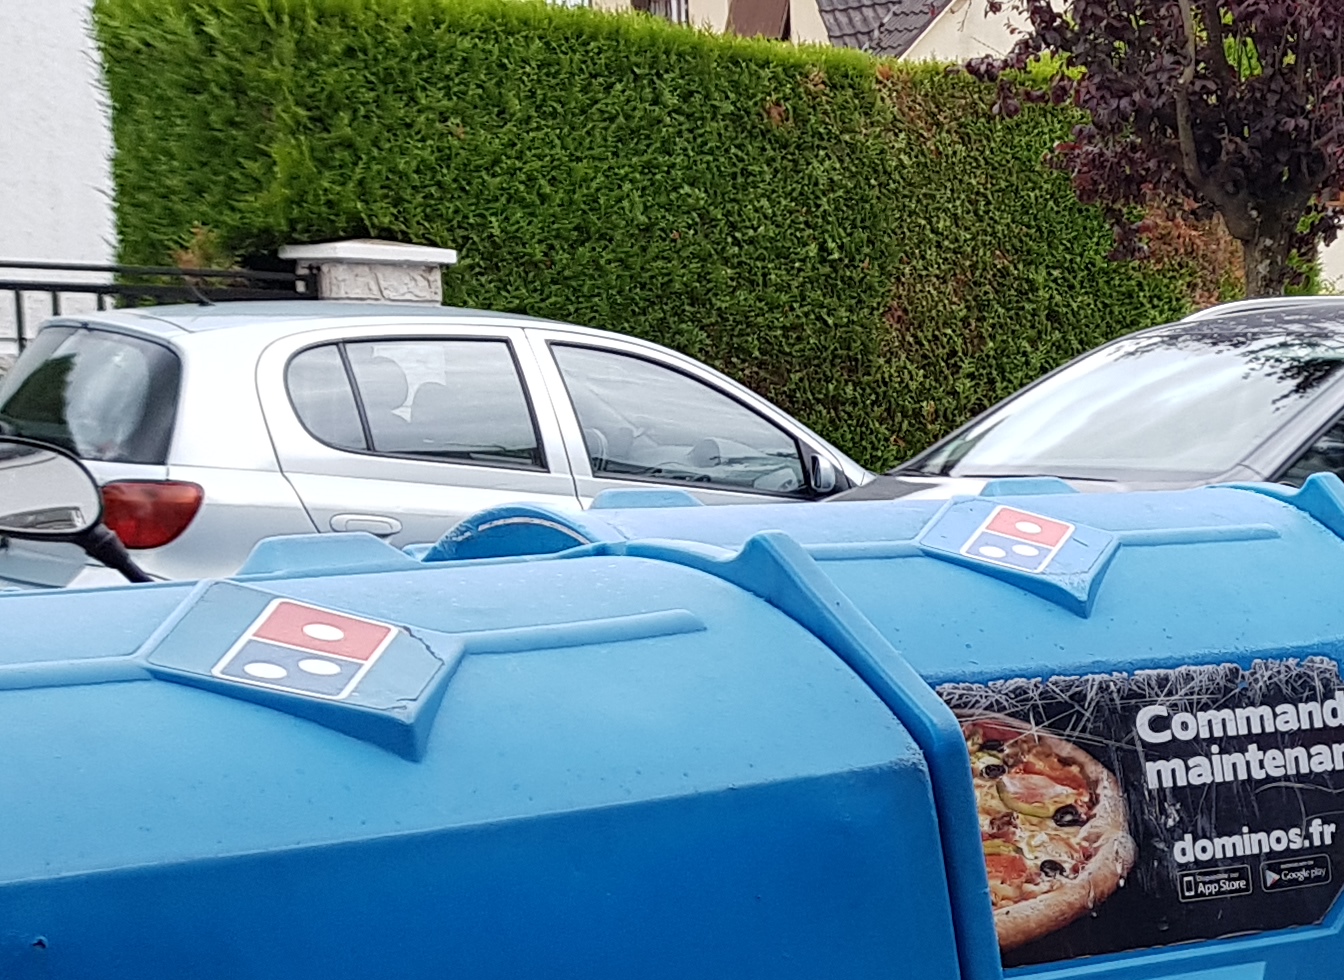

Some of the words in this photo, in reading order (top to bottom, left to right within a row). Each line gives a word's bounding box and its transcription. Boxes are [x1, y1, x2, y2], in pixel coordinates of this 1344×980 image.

[1174, 818, 1336, 863] dominos.fr
[1198, 882, 1218, 895] App
[1220, 879, 1247, 891] Store
